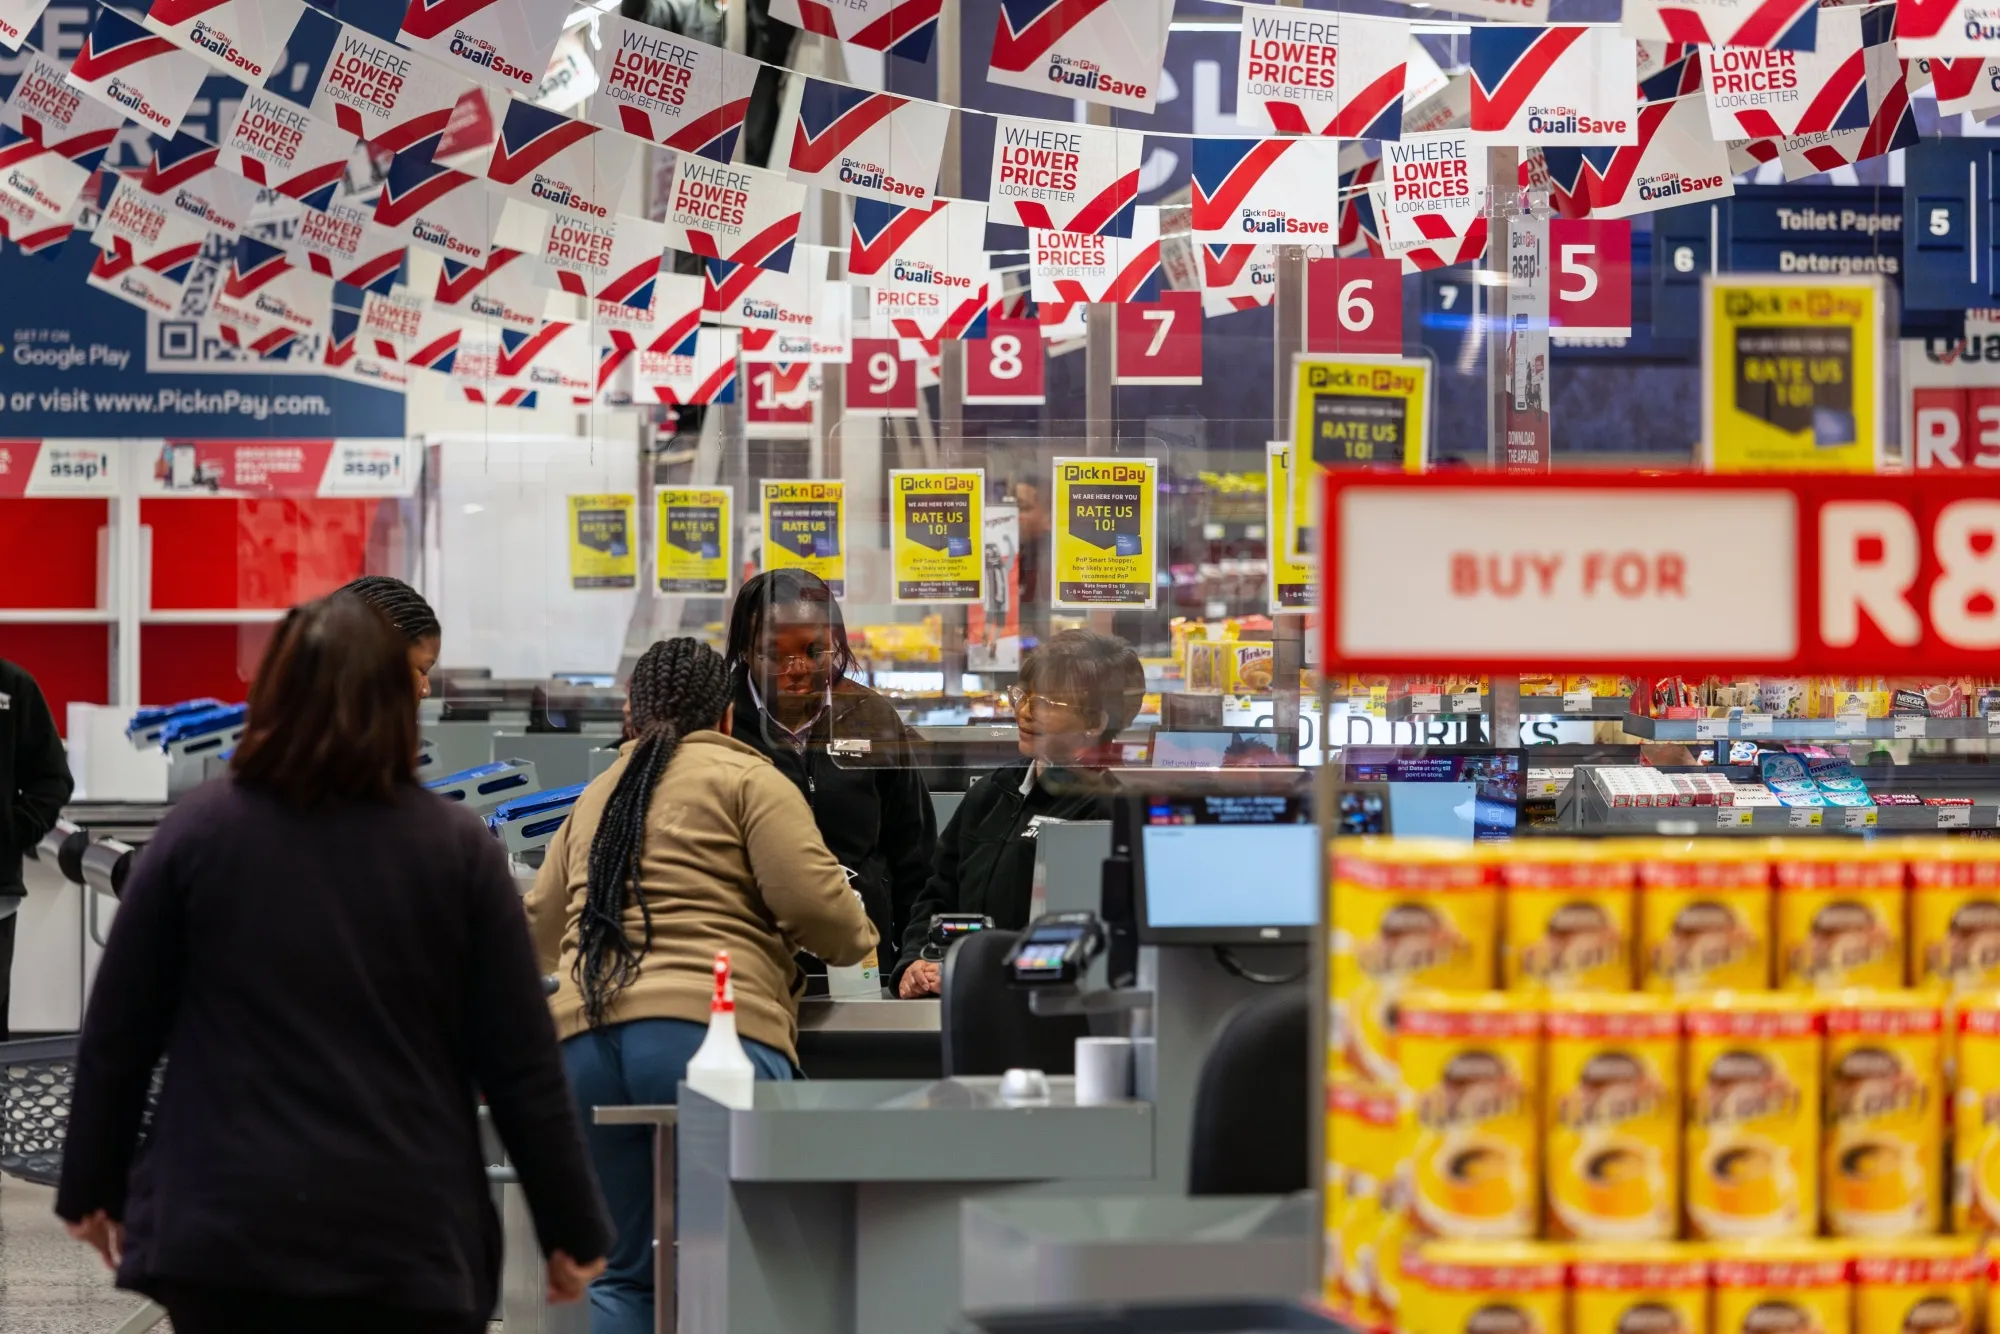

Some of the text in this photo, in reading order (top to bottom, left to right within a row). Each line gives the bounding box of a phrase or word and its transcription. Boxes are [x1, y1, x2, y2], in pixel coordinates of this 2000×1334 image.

[1252, 17, 1339, 45] WHERE
[190, 29, 262, 76] QualiSave
[345, 36, 411, 78] WHERE
[449, 39, 533, 84] QualiSave
[622, 30, 698, 69] WHERE
[1250, 39, 1337, 66] LOWER
[1710, 50, 1796, 73] LOWER
[336, 53, 404, 94] LOWER
[614, 48, 692, 88] LOWER
[1248, 62, 1335, 89] PRICES
[26, 73, 80, 112] LOWER
[329, 69, 397, 109] PRICES
[609, 69, 686, 106] PRICES
[1048, 65, 1146, 100] QualiSave
[1247, 83, 1334, 102] LOOK BETTER
[1713, 70, 1797, 94] PRICES
[19, 87, 73, 124] PRICES
[107, 85, 171, 127] QualiSave
[251, 94, 310, 133] WHERE
[325, 84, 391, 120] LOOK BETTER
[605, 85, 681, 118] LOOK BETTER
[242, 110, 303, 147] LOWER
[1528, 116, 1626, 134] QualiSave
[236, 125, 297, 160] PRICES
[1004, 127, 1082, 152] WHERE
[1391, 140, 1467, 164] WHERE
[1002, 146, 1079, 172] LOWER
[1393, 159, 1467, 182] LOWER
[684, 162, 751, 191] WHERE
[839, 167, 925, 199] QualiSave
[1000, 166, 1077, 191] PRICES
[1640, 175, 1723, 200] QualiSave
[531, 183, 607, 217] QualiSave
[678, 182, 748, 209] LOWER
[998, 184, 1075, 202] LOOK BETTER
[1394, 179, 1469, 201] PRICES
[175, 196, 236, 230] QualiSave
[675, 199, 743, 224] PRICES
[1395, 197, 1470, 214] LOOK BETTER
[672, 213, 742, 236] LOOK BETTER
[1242, 217, 1329, 234] QualiSave
[1777, 209, 1902, 235] Toilet Paper
[1929, 209, 1950, 235] 5
[412, 226, 481, 258] QualiSave
[551, 225, 614, 252] LOWER
[1037, 232, 1105, 249] LOWER
[547, 241, 610, 267] PRICES
[1037, 251, 1105, 266] PRICES
[1674, 247, 1694, 272] 6
[1780, 252, 1898, 274] Detergents
[894, 267, 971, 288] QualiSave
[1560, 245, 1598, 301] 5
[877, 292, 939, 305] PRICES
[1338, 279, 1374, 331] 6
[1440, 286, 1458, 309] 7
[743, 306, 813, 325] QualiSave
[1142, 311, 1176, 356] 7
[14, 344, 129, 371] Google Play
[989, 335, 1022, 379] 8
[868, 352, 898, 394] 9
[11, 388, 331, 420] or visit www.PicknPay.com.
[1321, 422, 1397, 442] RATE US
[1508, 431, 1535, 446] DOWNLOAD
[1344, 443, 1373, 459] 10!
[50, 454, 108, 480] asap!
[1065, 466, 1145, 483] Pick n Pay
[901, 478, 932, 490] Pick
[944, 477, 973, 491] Pay
[912, 512, 963, 523] RATE US
[1076, 506, 1132, 517] RATE US
[782, 521, 825, 531] RATE US
[928, 525, 947, 535] 10!
[1095, 520, 1115, 531] 10!
[797, 534, 811, 544] 10!
[1450, 553, 1687, 599] BUY FOR
[1764, 702, 1785, 710] MUG
[1810, 760, 1848, 773] mentos
